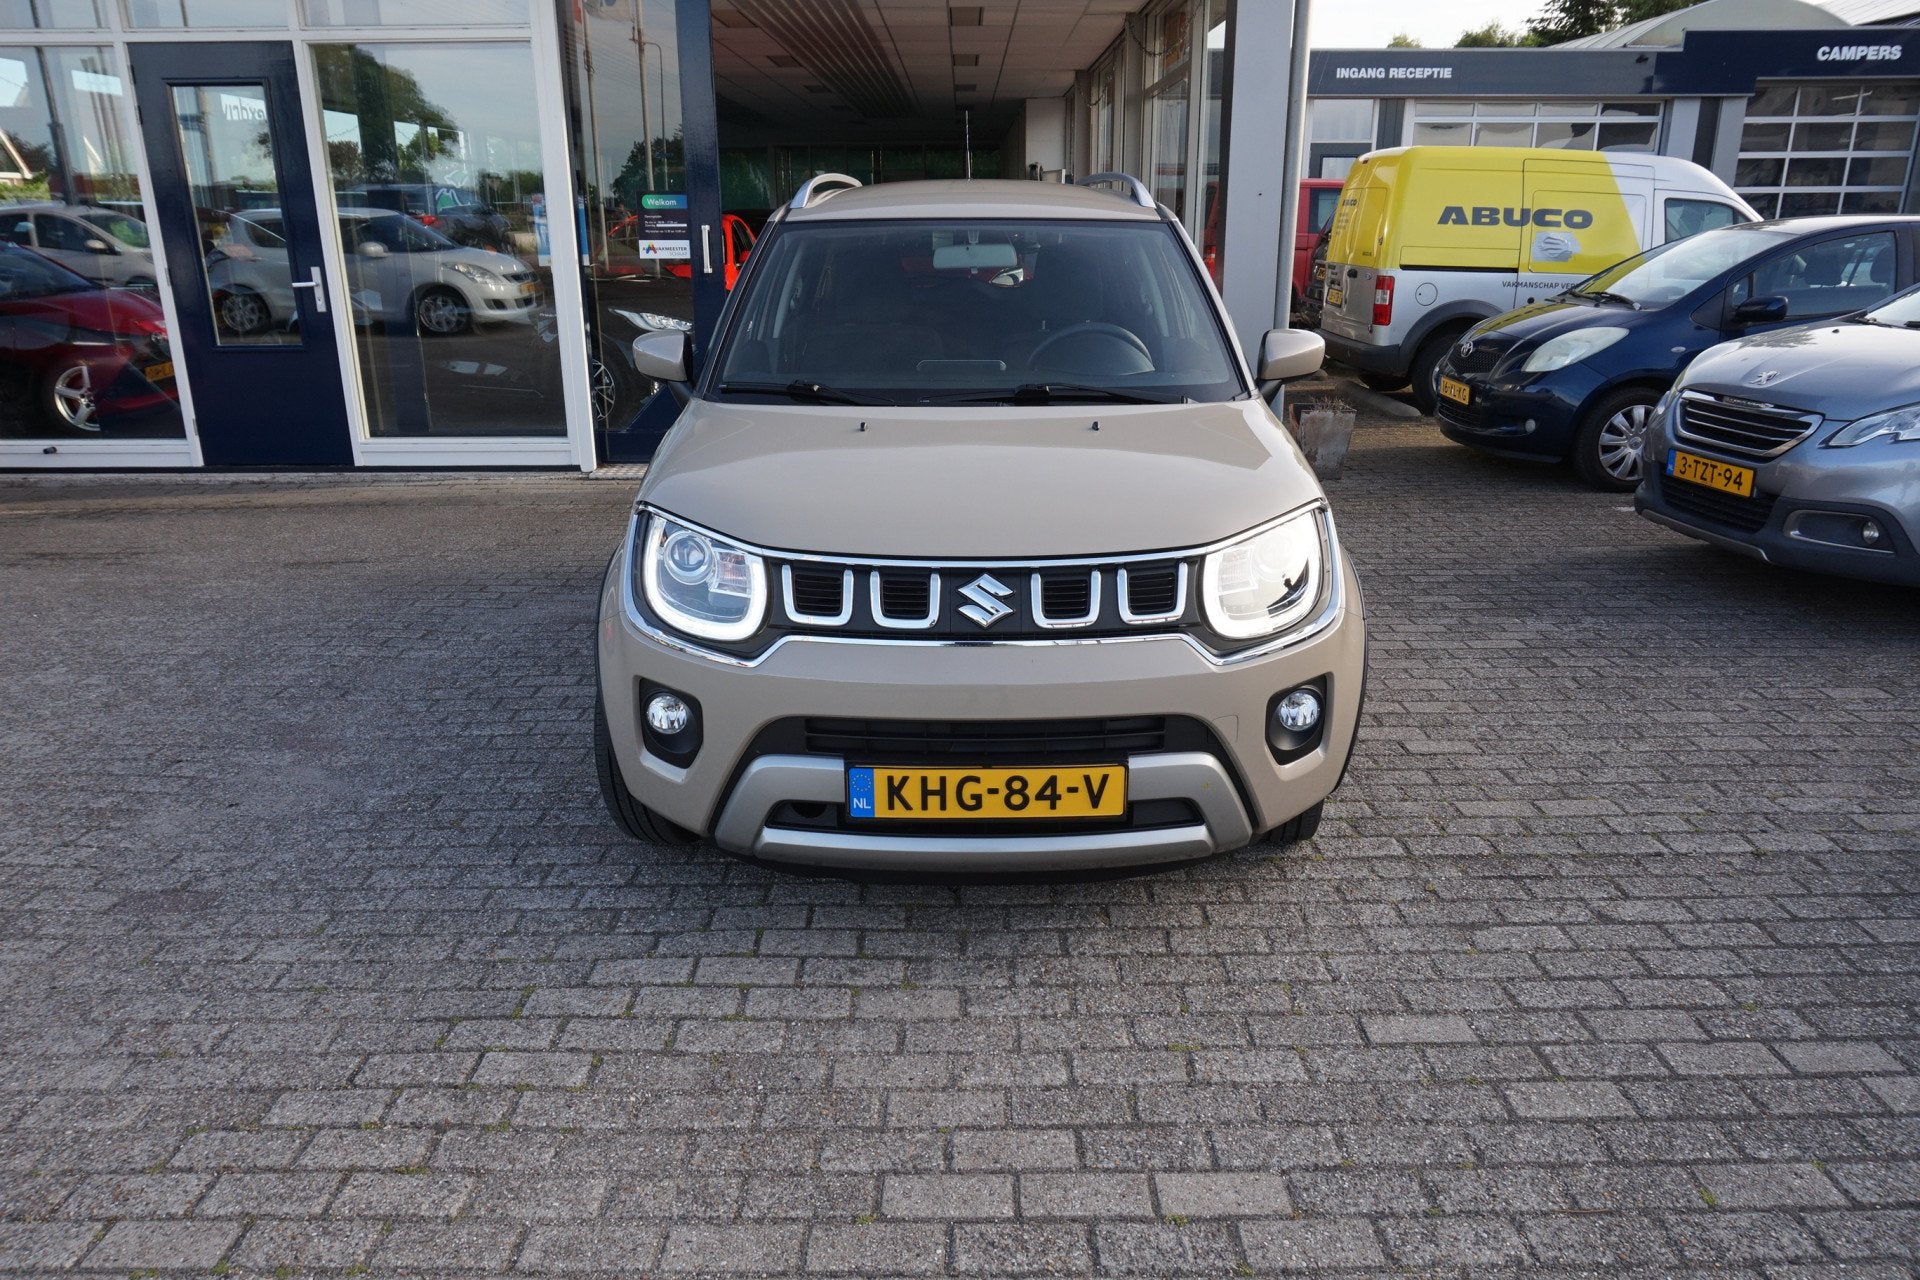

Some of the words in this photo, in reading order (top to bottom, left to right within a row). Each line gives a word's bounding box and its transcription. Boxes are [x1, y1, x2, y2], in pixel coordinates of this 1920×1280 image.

[1817, 45, 1902, 61] CAMPERS
[1336, 67, 1386, 79] INGANG
[1389, 67, 1453, 79] RECEPTIE
[647, 198, 677, 206] Welkom
[1437, 206, 1593, 229] ABUCO
[1502, 281, 1560, 290] VAKMANSCHAP
[1680, 457, 1744, 491] 3-TZT-94
[853, 797, 871, 810] NL
[887, 773, 1110, 812] KHG-84-V
